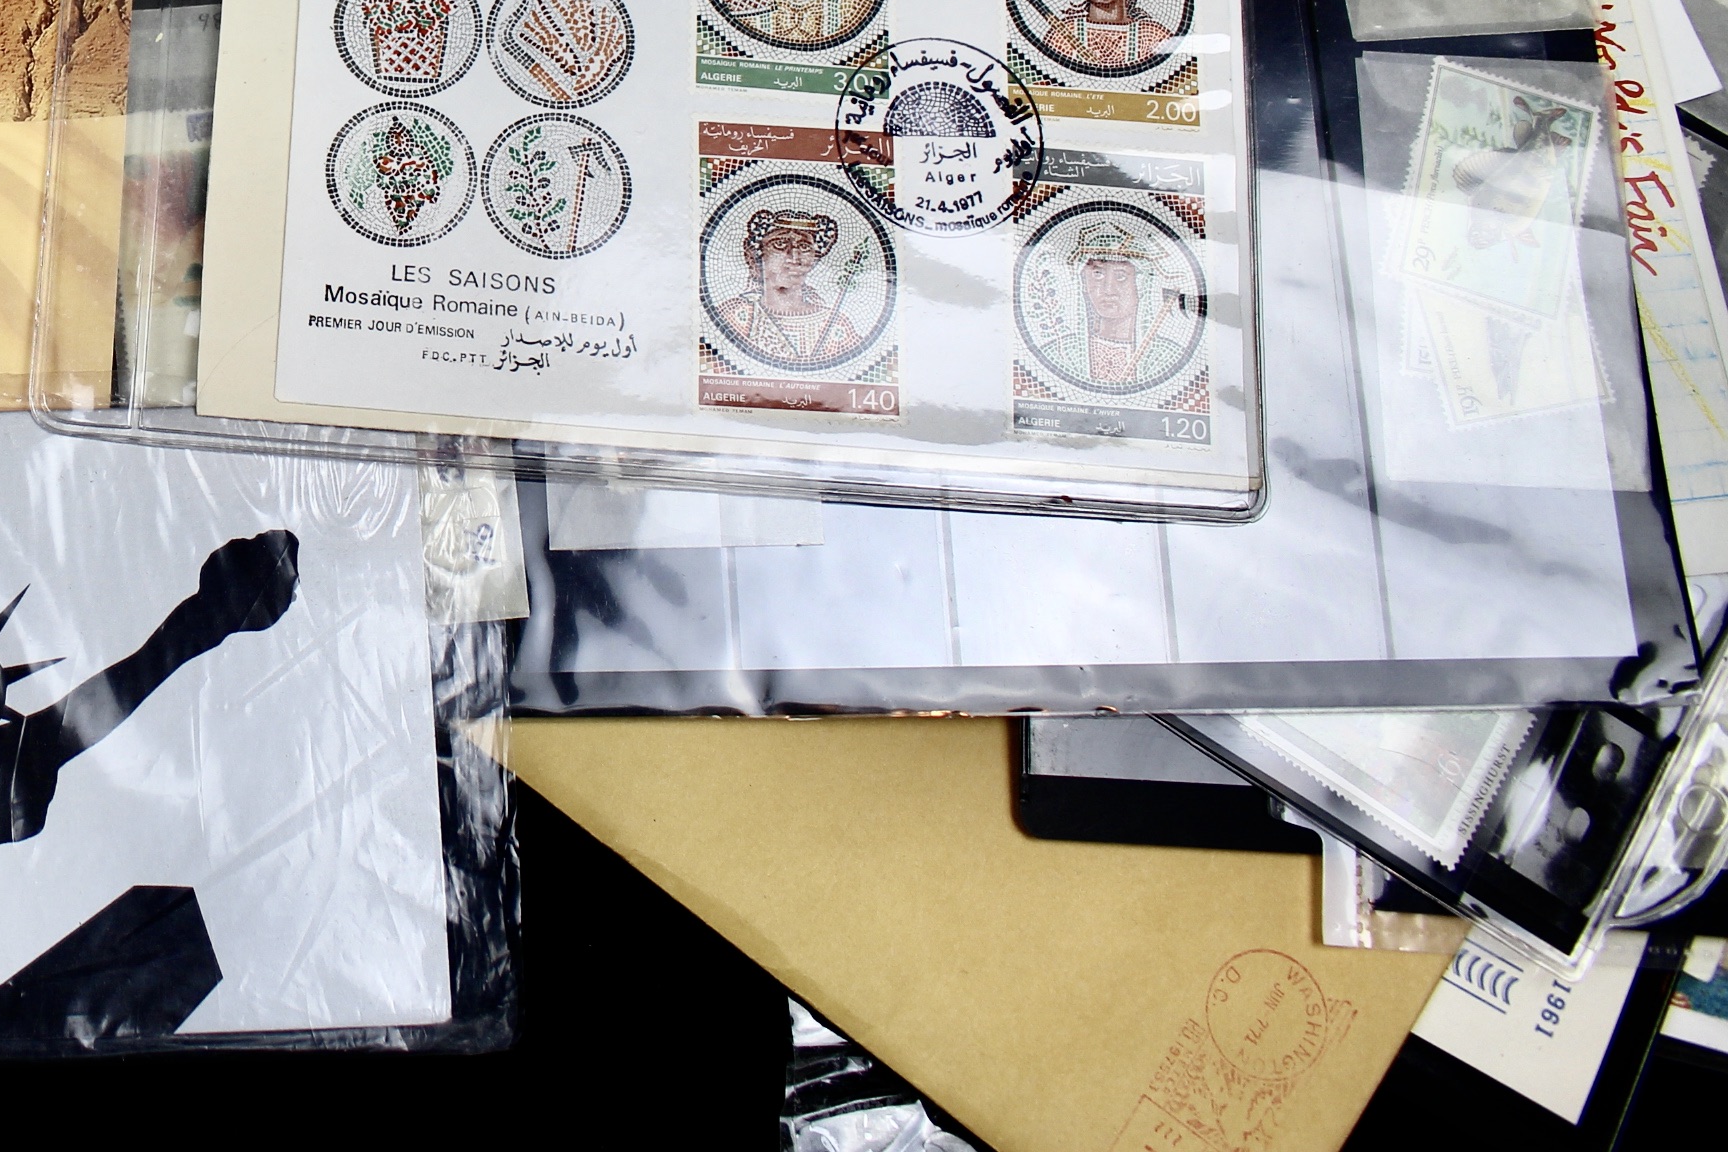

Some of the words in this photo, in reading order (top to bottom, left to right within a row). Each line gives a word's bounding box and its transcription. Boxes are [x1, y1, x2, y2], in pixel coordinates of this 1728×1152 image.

[700, 71, 742, 84] ALGERIE
[738, 60, 773, 70] ROMAINE
[783, 65, 823, 76] PRINTEMPS
[1145, 99, 1197, 123] 2.00
[925, 171, 977, 185] Alger
[1622, 170, 1676, 278] Fair
[390, 263, 432, 284] LES
[448, 268, 557, 296] SAISONS
[323, 283, 424, 312] Mosaïque
[432, 294, 519, 319] Romaine
[308, 313, 362, 331] PREMIER
[367, 317, 403, 334] JOUR
[405, 320, 476, 341] D'EMISSION
[702, 392, 747, 404] ALGERIE
[847, 387, 896, 412] 1.40
[1017, 416, 1062, 429] ALGERIE
[1160, 416, 1208, 441] 1.20
[1457, 743, 1511, 835] SISSINGHURST
[1534, 978, 1572, 1038] 1961
